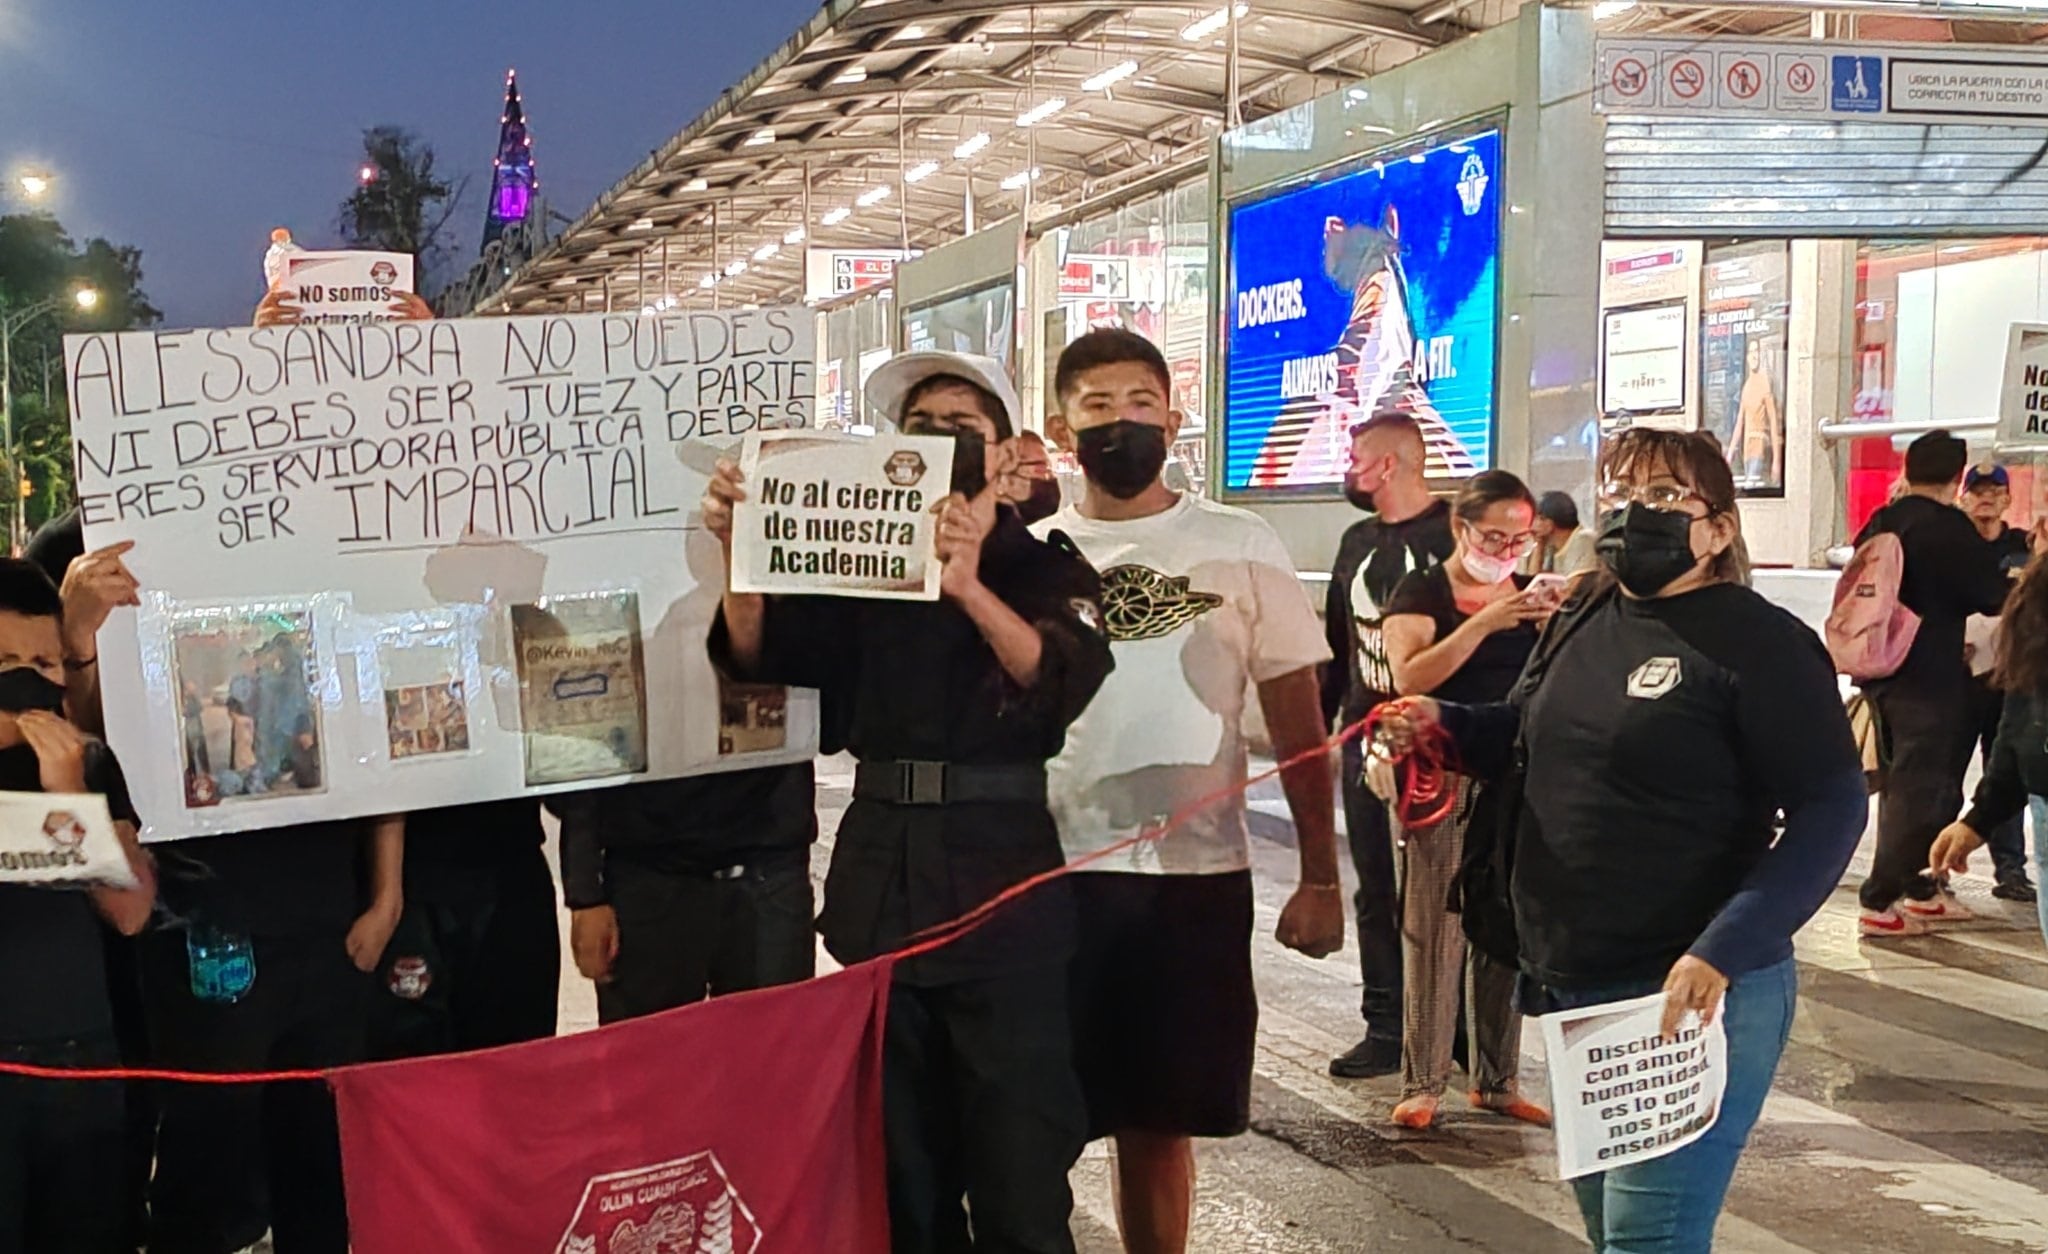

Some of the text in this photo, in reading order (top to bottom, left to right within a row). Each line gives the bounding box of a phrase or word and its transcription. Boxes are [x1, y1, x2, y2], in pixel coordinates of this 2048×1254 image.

[1943, 76, 1958, 87] LA
[1980, 90, 1994, 102] TU
[299, 285, 392, 303] NO somos
[1238, 278, 1307, 329] DOCKERS.
[73, 310, 795, 421] ALESSANDRA NO PUEDES
[1280, 335, 1457, 399] ALWAYS A FIT.
[2025, 390, 2048, 411] de
[76, 360, 816, 482] NI DEBES SER JUEZ Y PARTE
[80, 473, 205, 526] ERES
[222, 428, 457, 501] SERVIDORA
[667, 400, 807, 442] DEBES
[218, 445, 680, 549] SER IMPARCIAL
[761, 477, 923, 512] No al cierre
[764, 511, 915, 546] de nuestra
[768, 545, 906, 580] Academia
[1587, 1027, 1703, 1064] Discipin
[1586, 1063, 1629, 1085] con
[1635, 1045, 1698, 1073] amor
[1601, 1081, 1701, 1121] es lo que
[1608, 1101, 1697, 1139] nos han
